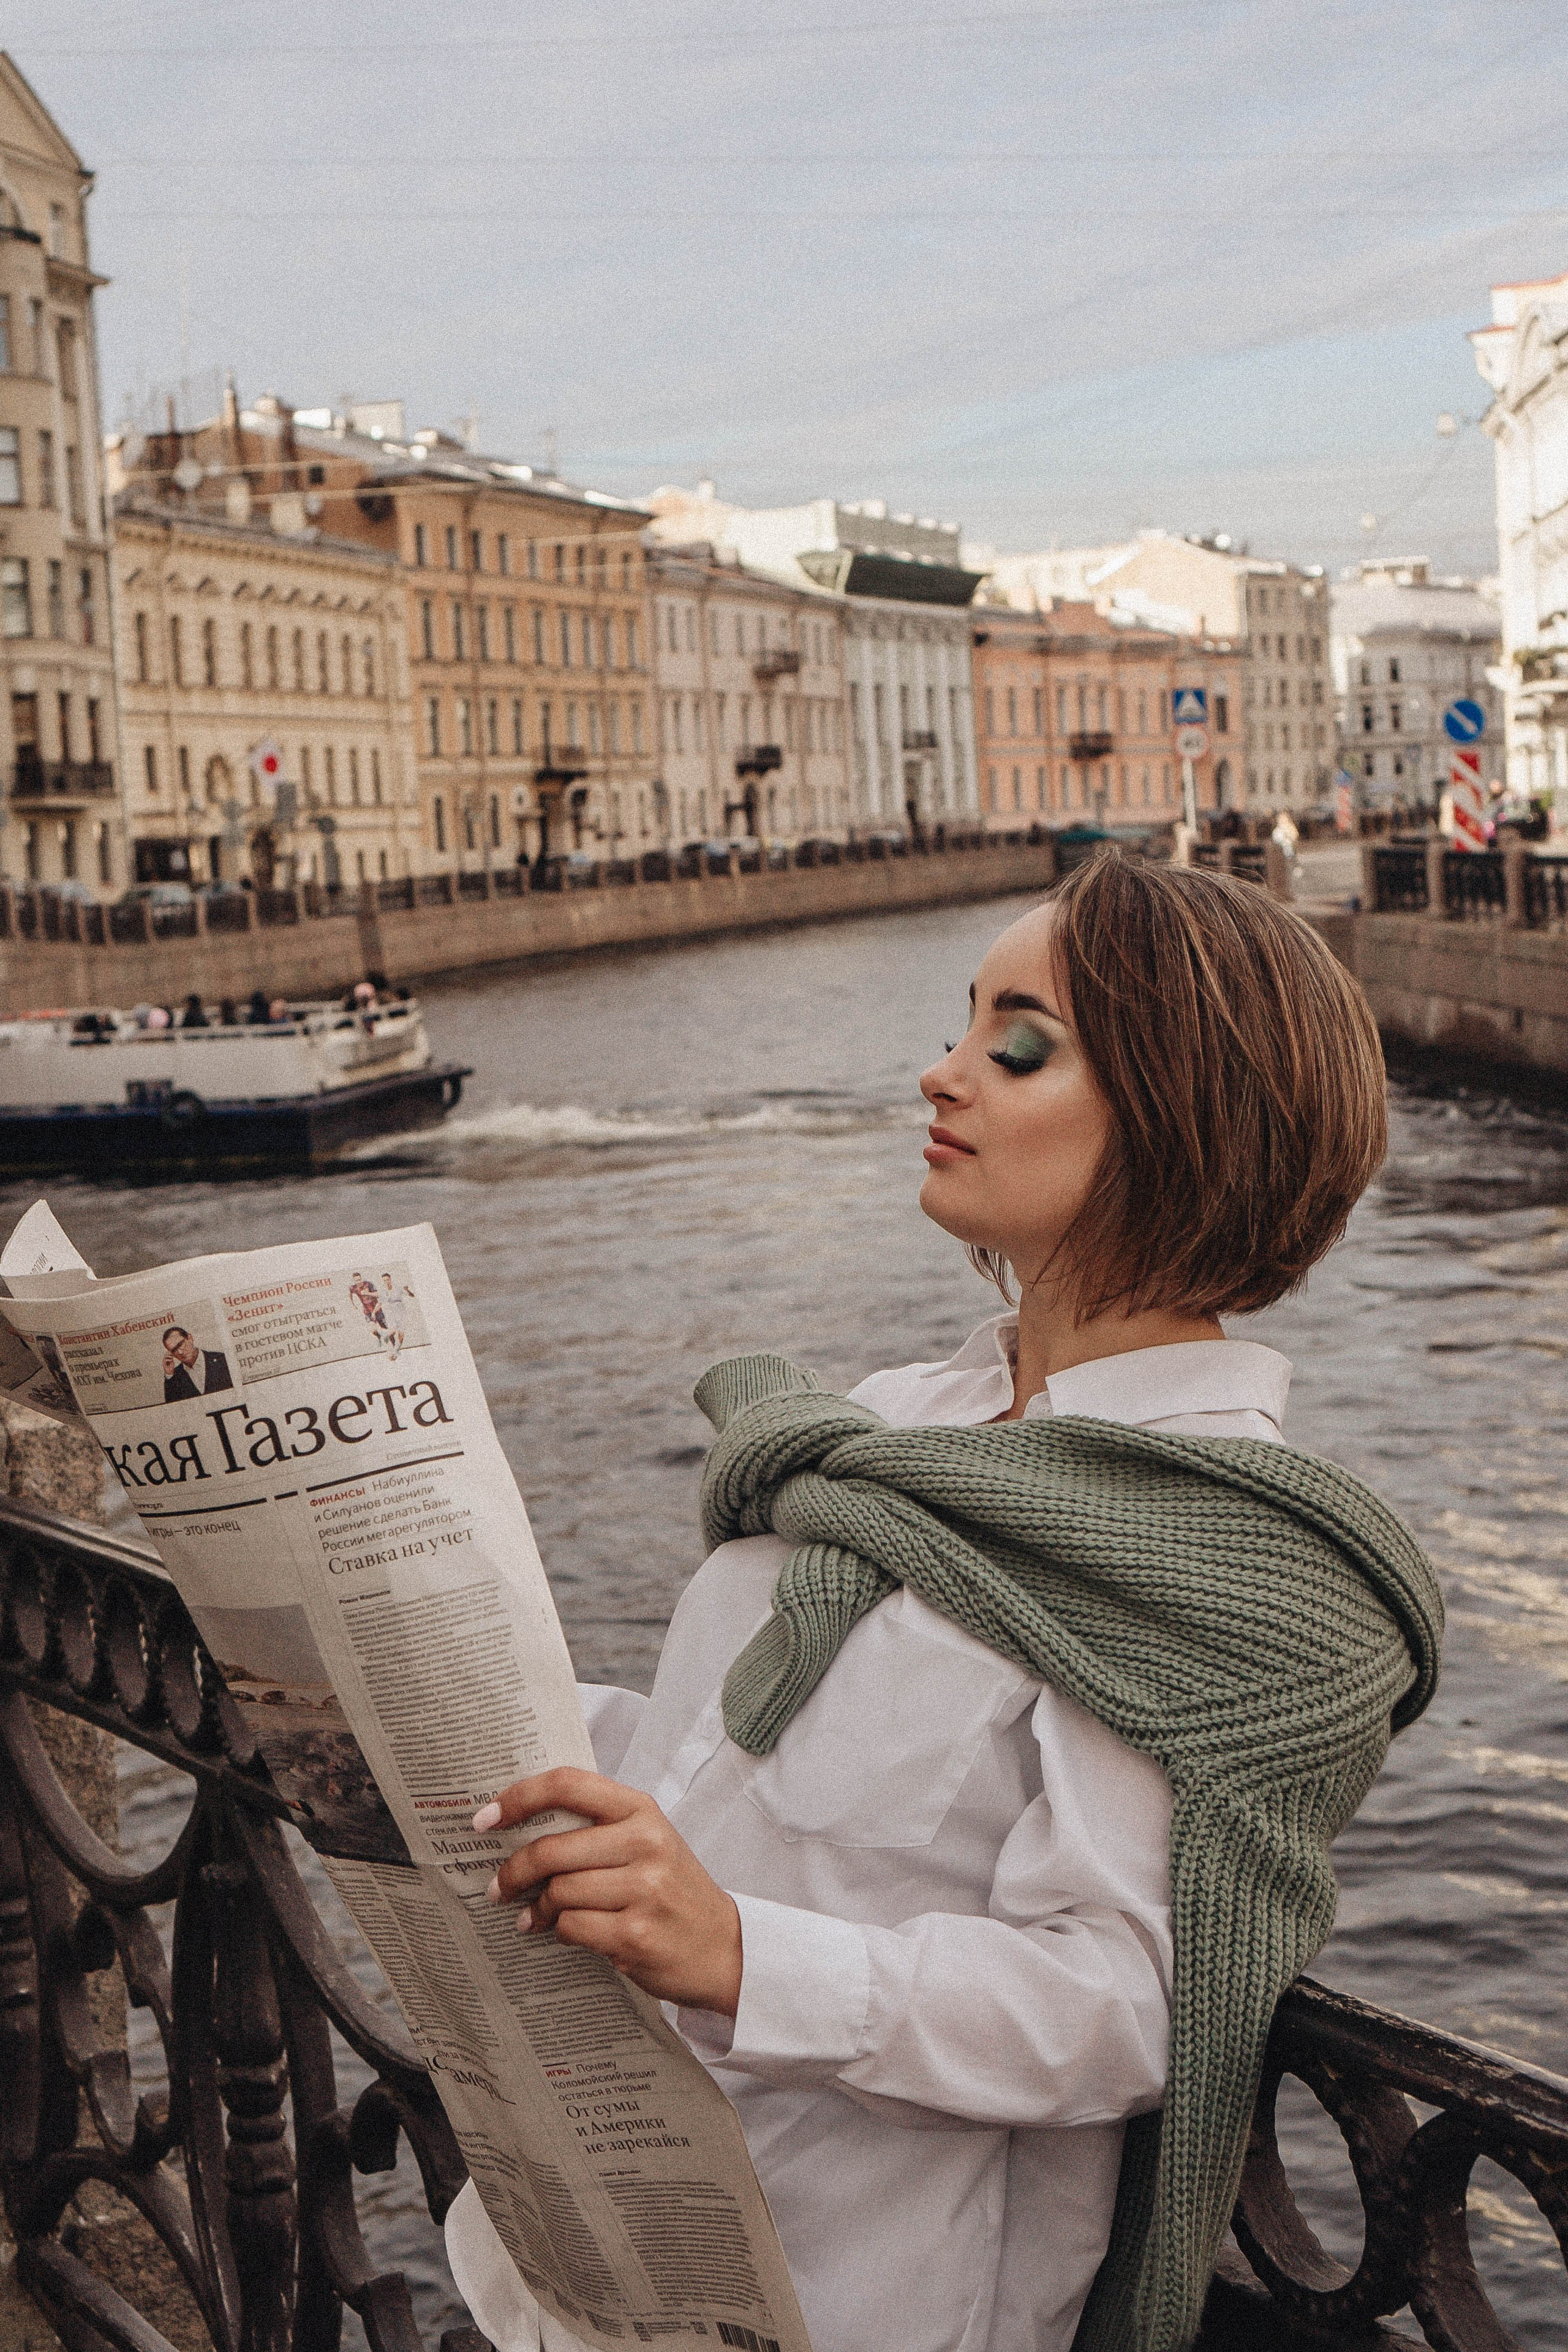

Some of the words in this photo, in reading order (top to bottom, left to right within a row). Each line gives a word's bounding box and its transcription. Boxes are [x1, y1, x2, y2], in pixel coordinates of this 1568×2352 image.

[223, 1286, 284, 1308] Чемпион
[285, 1278, 331, 1293] России
[111, 1312, 175, 1337] Хабенский
[232, 1324, 262, 1337] смог
[263, 1306, 337, 1329] отыграться
[235, 1344, 243, 1353] в
[244, 1329, 303, 1351] гостевом
[306, 1320, 343, 1335] матче
[239, 1349, 285, 1368] против
[288, 1336, 327, 1355] ЦСКА
[104, 1434, 211, 1488] кая
[206, 1379, 454, 1476] Газета
[310, 1488, 365, 1507] ФИНАНСЫ
[372, 1468, 445, 1491] Набиуллина
[323, 1499, 381, 1521] Силуанов
[383, 1486, 435, 1506] оценили
[184, 1526, 202, 1536] это
[203, 1521, 241, 1533] конец
[318, 1518, 371, 1540] решение
[373, 1507, 421, 1525] сделать
[423, 1498, 452, 1511] Банк
[322, 1536, 364, 1553] России
[367, 1509, 472, 1542] мегарегулятором
[328, 1548, 398, 1574] Ставка
[401, 1540, 425, 1558] на
[428, 1528, 473, 1555] учет
[414, 1798, 471, 1808] АВТОМОБИЛИ
[419, 1812, 475, 1823] видеокамер
[431, 1839, 502, 1855] Машина
[443, 1864, 453, 1874] с
[455, 1857, 505, 1875] фокус
[576, 2060, 617, 2073] Почему
[551, 2071, 623, 2090] Коломойский
[623, 2070, 657, 2081] решил
[558, 2089, 603, 2101] остаться
[612, 2083, 652, 2095] тюрьме
[566, 2105, 589, 2119] От
[594, 2101, 641, 2118] сумы
[575, 2126, 587, 2136] и
[590, 2118, 666, 2135] Америки
[584, 2143, 606, 2154] не
[608, 2133, 690, 2154] зарекайся
